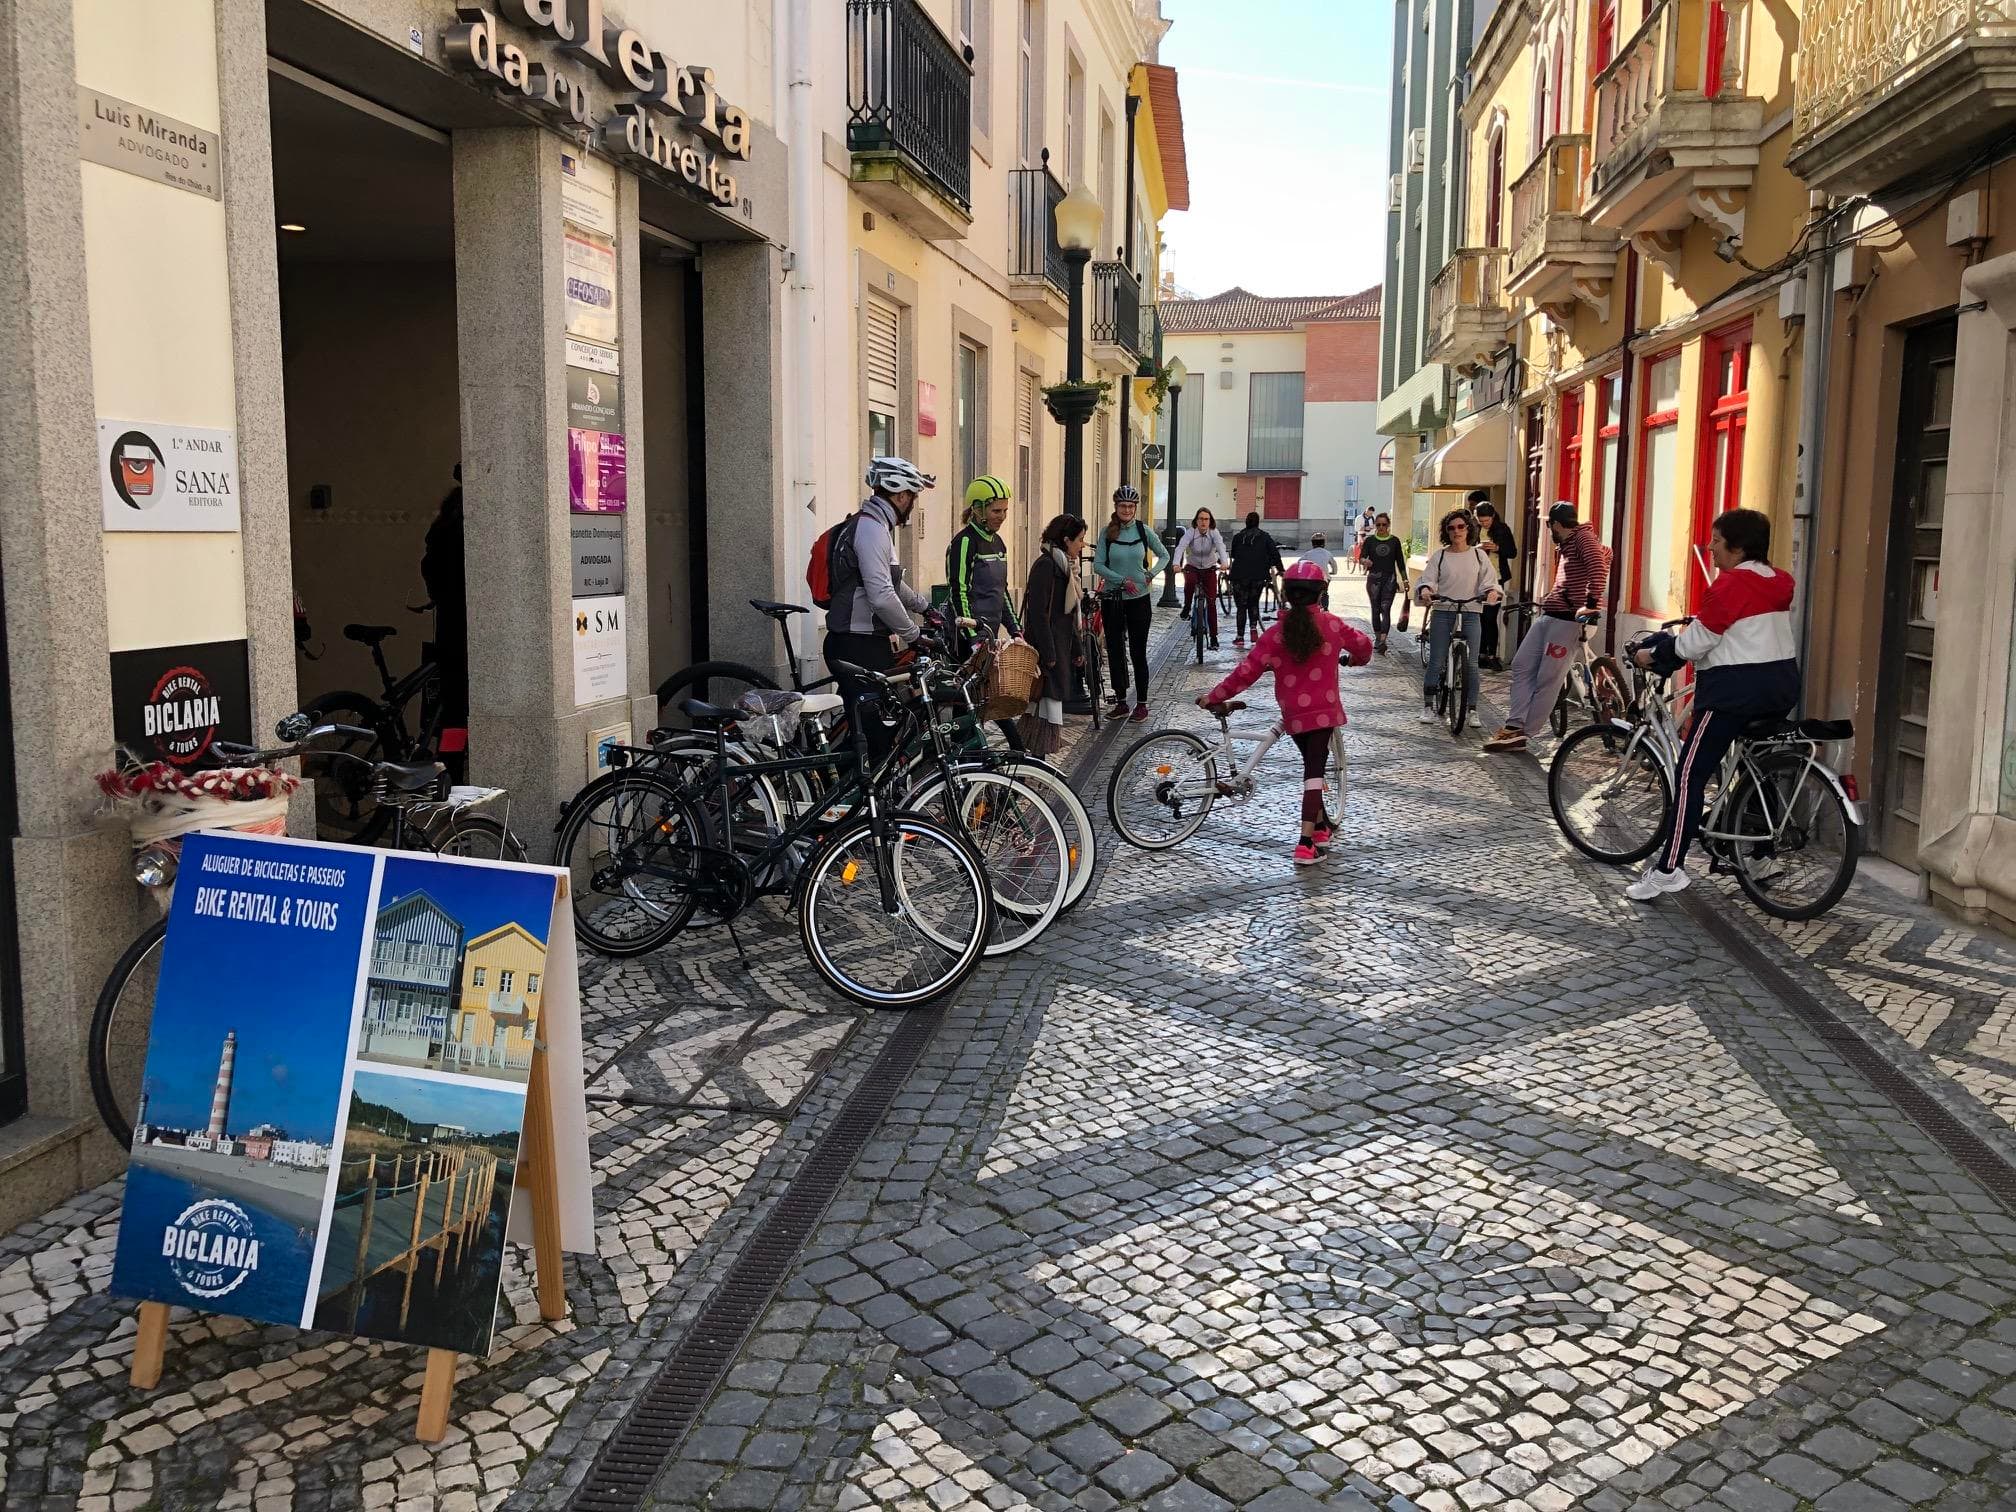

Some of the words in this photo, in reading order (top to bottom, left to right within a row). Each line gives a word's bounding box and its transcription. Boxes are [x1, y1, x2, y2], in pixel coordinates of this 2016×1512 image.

[468, 7, 533, 97] da
[624, 103, 738, 205] direita
[94, 98, 132, 129] Luis
[136, 113, 208, 155] Miranda
[118, 136, 190, 170] ADVOGADO
[186, 438, 223, 454] ANDAR
[175, 469, 231, 495] SANA
[188, 496, 223, 507] EDITORA
[580, 555, 612, 565] ADVOGADA
[162, 679, 178, 699] BIKE
[178, 676, 201, 695] RENTAL
[144, 696, 220, 737] BICLARIA
[176, 737, 198, 753] TOURS
[201, 853, 240, 875] ALUGUER
[241, 858, 253, 877] DE
[253, 859, 299, 882] BICICLETAS
[299, 865, 307, 883] E
[306, 866, 346, 888] PASSEIOS
[194, 886, 227, 917] BIKE
[227, 890, 277, 924] RENTAL
[280, 896, 291, 925] &
[295, 898, 339, 931] TOURS
[190, 1209, 210, 1227] BIKE
[212, 1209, 241, 1233] RENTAL
[162, 1225, 260, 1270] BICLARIA
[194, 1273, 224, 1287] TOURS
